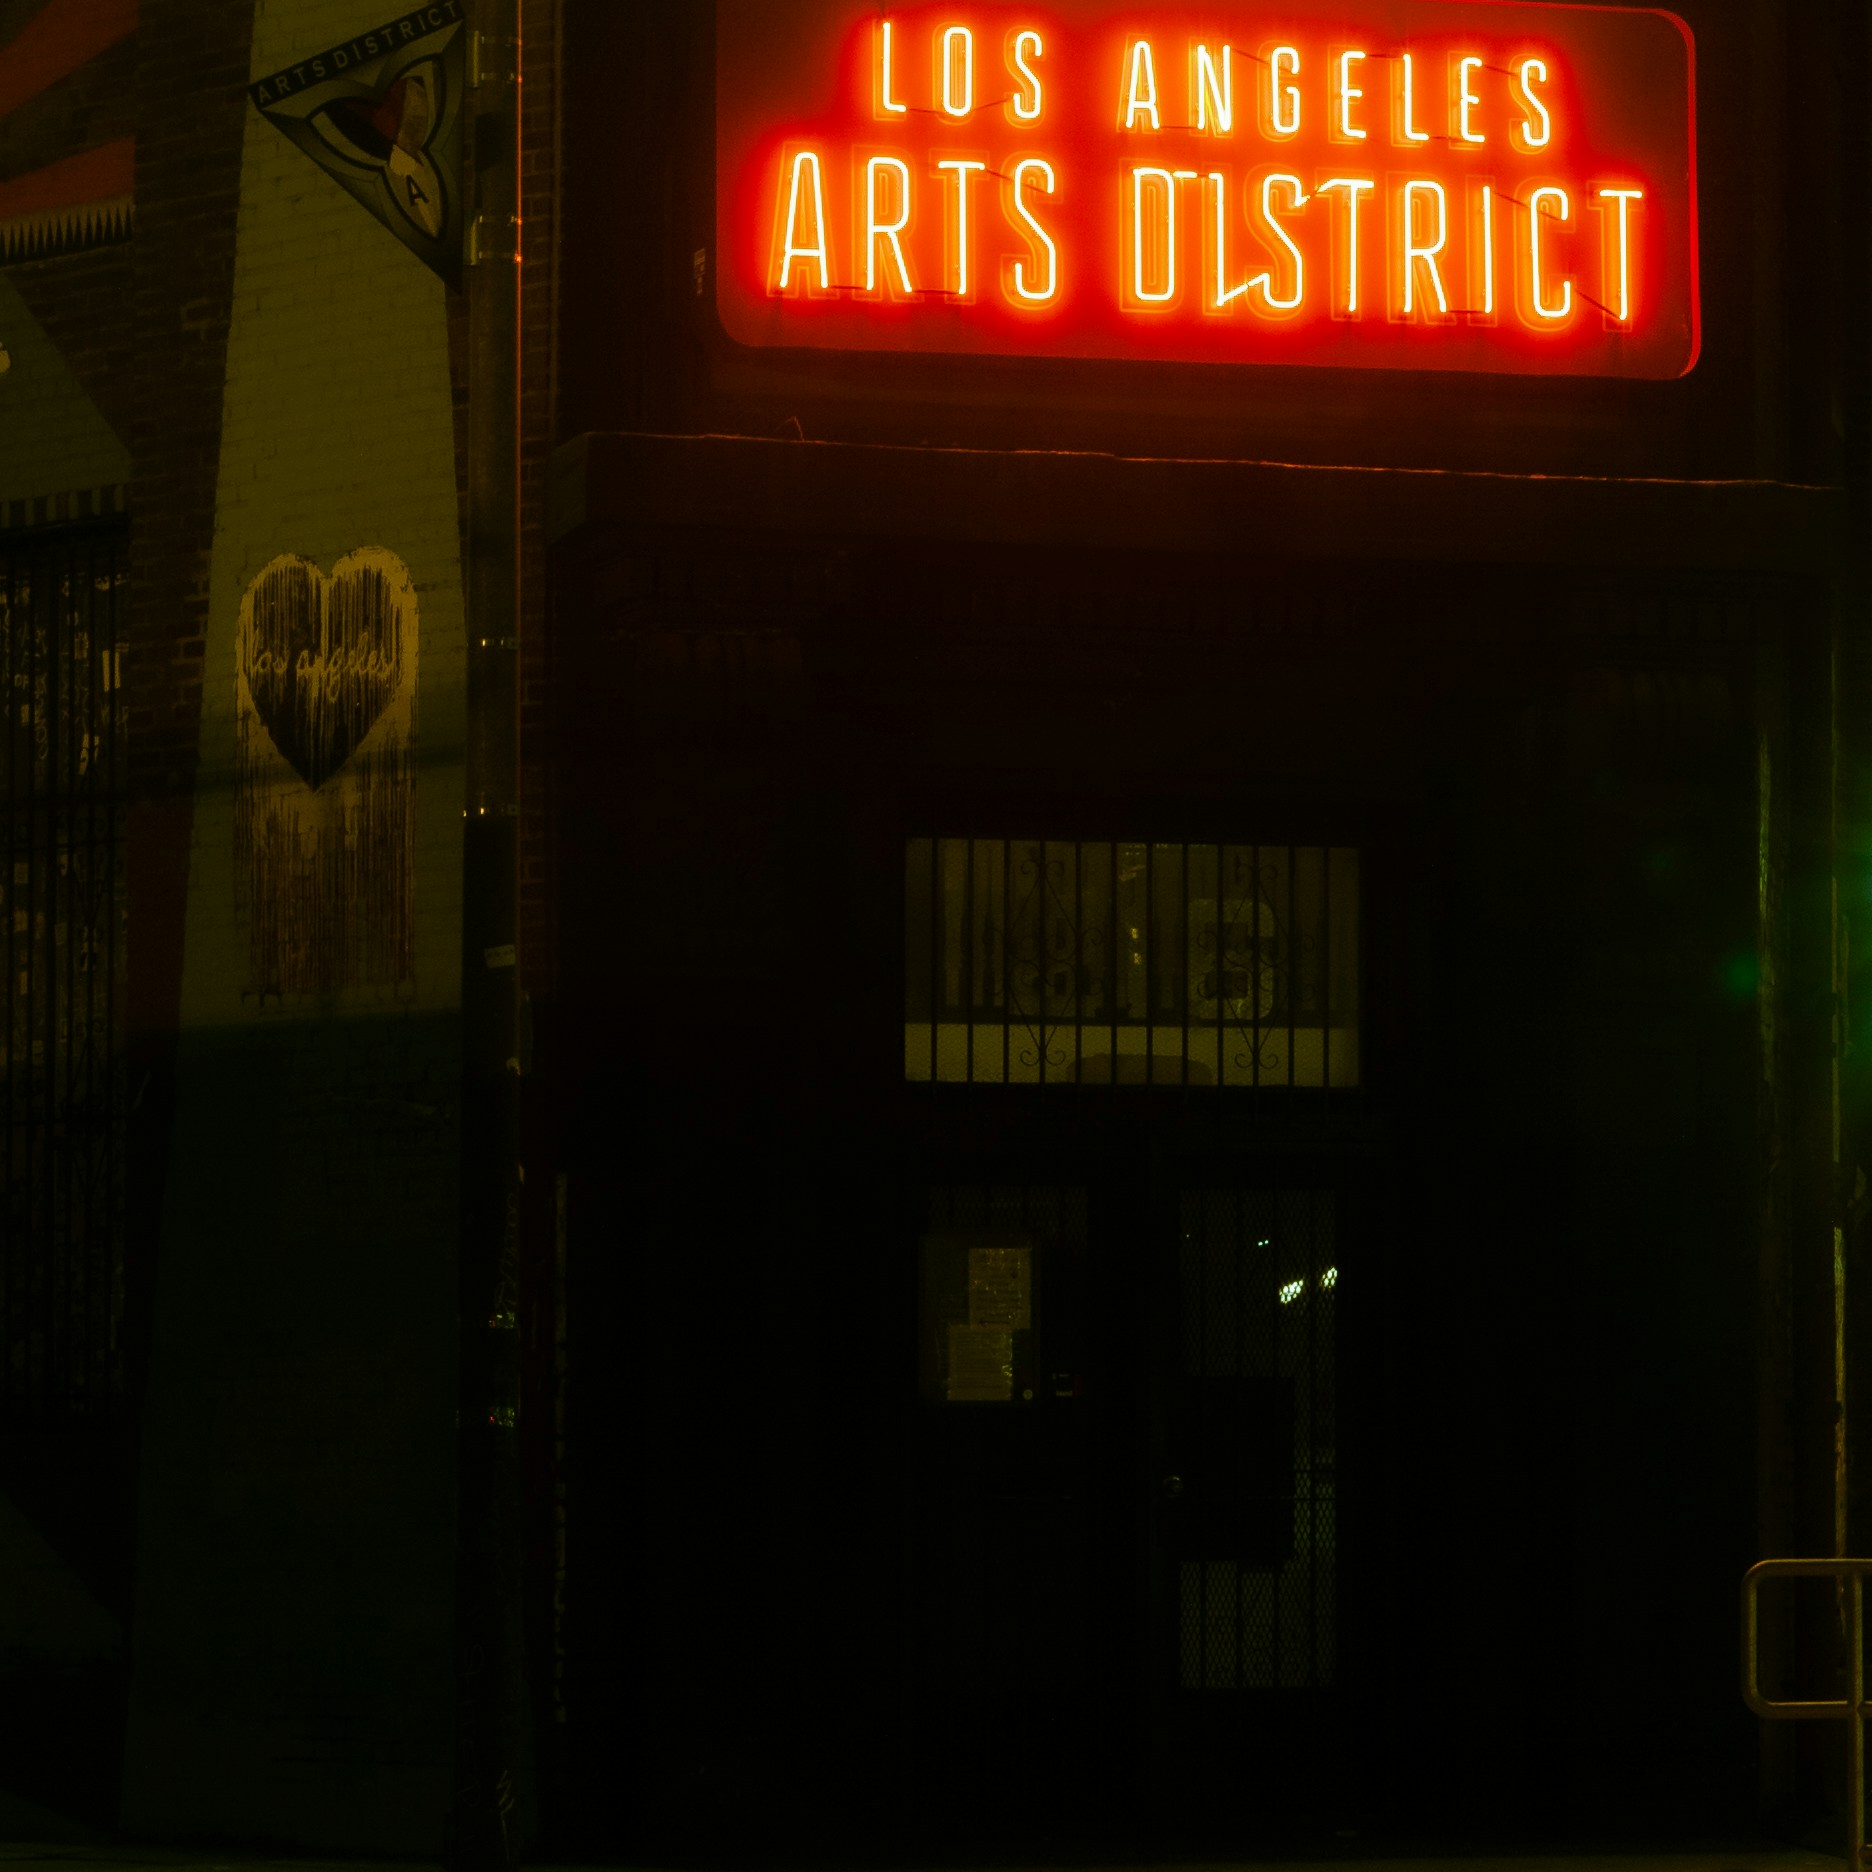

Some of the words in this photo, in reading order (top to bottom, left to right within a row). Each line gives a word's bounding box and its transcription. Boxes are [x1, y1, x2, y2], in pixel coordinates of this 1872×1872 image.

[256, 57, 328, 105] ARTS
[333, 0, 458, 69] DISTRICT
[866, 21, 1048, 128] LOS
[1115, 32, 1556, 156] ANGELES
[765, 140, 1062, 312] ARTS
[1116, 156, 1652, 336] DISTRICT
